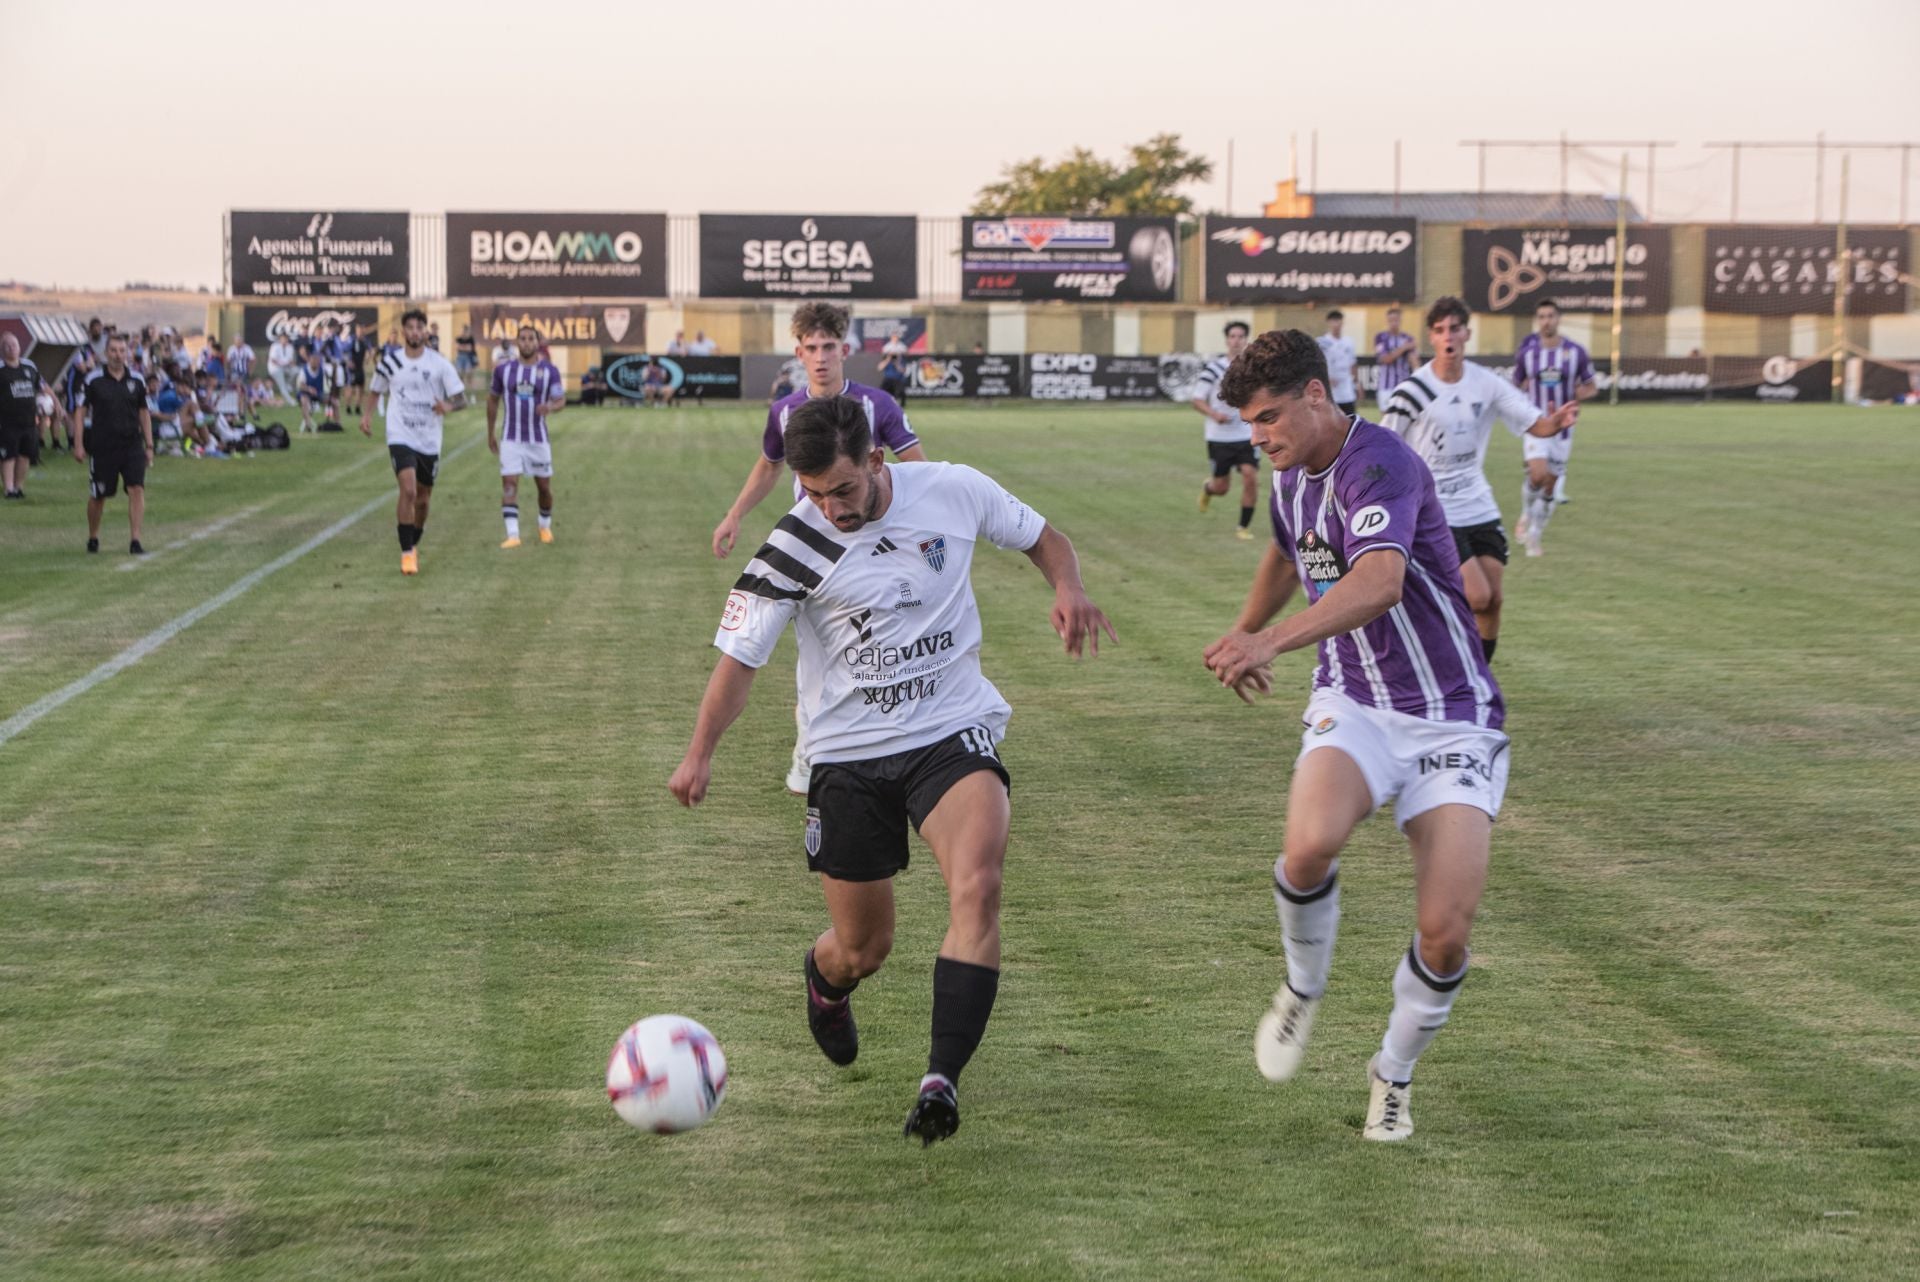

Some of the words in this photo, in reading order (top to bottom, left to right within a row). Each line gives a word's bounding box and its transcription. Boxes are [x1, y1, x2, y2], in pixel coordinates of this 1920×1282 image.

[248, 236, 313, 259] Agencia
[318, 236, 393, 256] Funeraria
[470, 230, 642, 262] BIOAMMO
[1277, 230, 1412, 254] SIGUERO
[742, 240, 873, 268] SEGESA
[1520, 236, 1648, 273] Magulo
[270, 256, 315, 275] Santa
[318, 256, 370, 275] Teresa
[470, 262, 561, 279] Biodegradable
[562, 262, 642, 277] Ammunition
[1226, 269, 1394, 291] www.siguero.net
[1031, 354, 1097, 371] EXPO
[1357, 511, 1384, 533] JD
[895, 599, 922, 611] SEGOVIA
[844, 630, 954, 672] cajaviva
